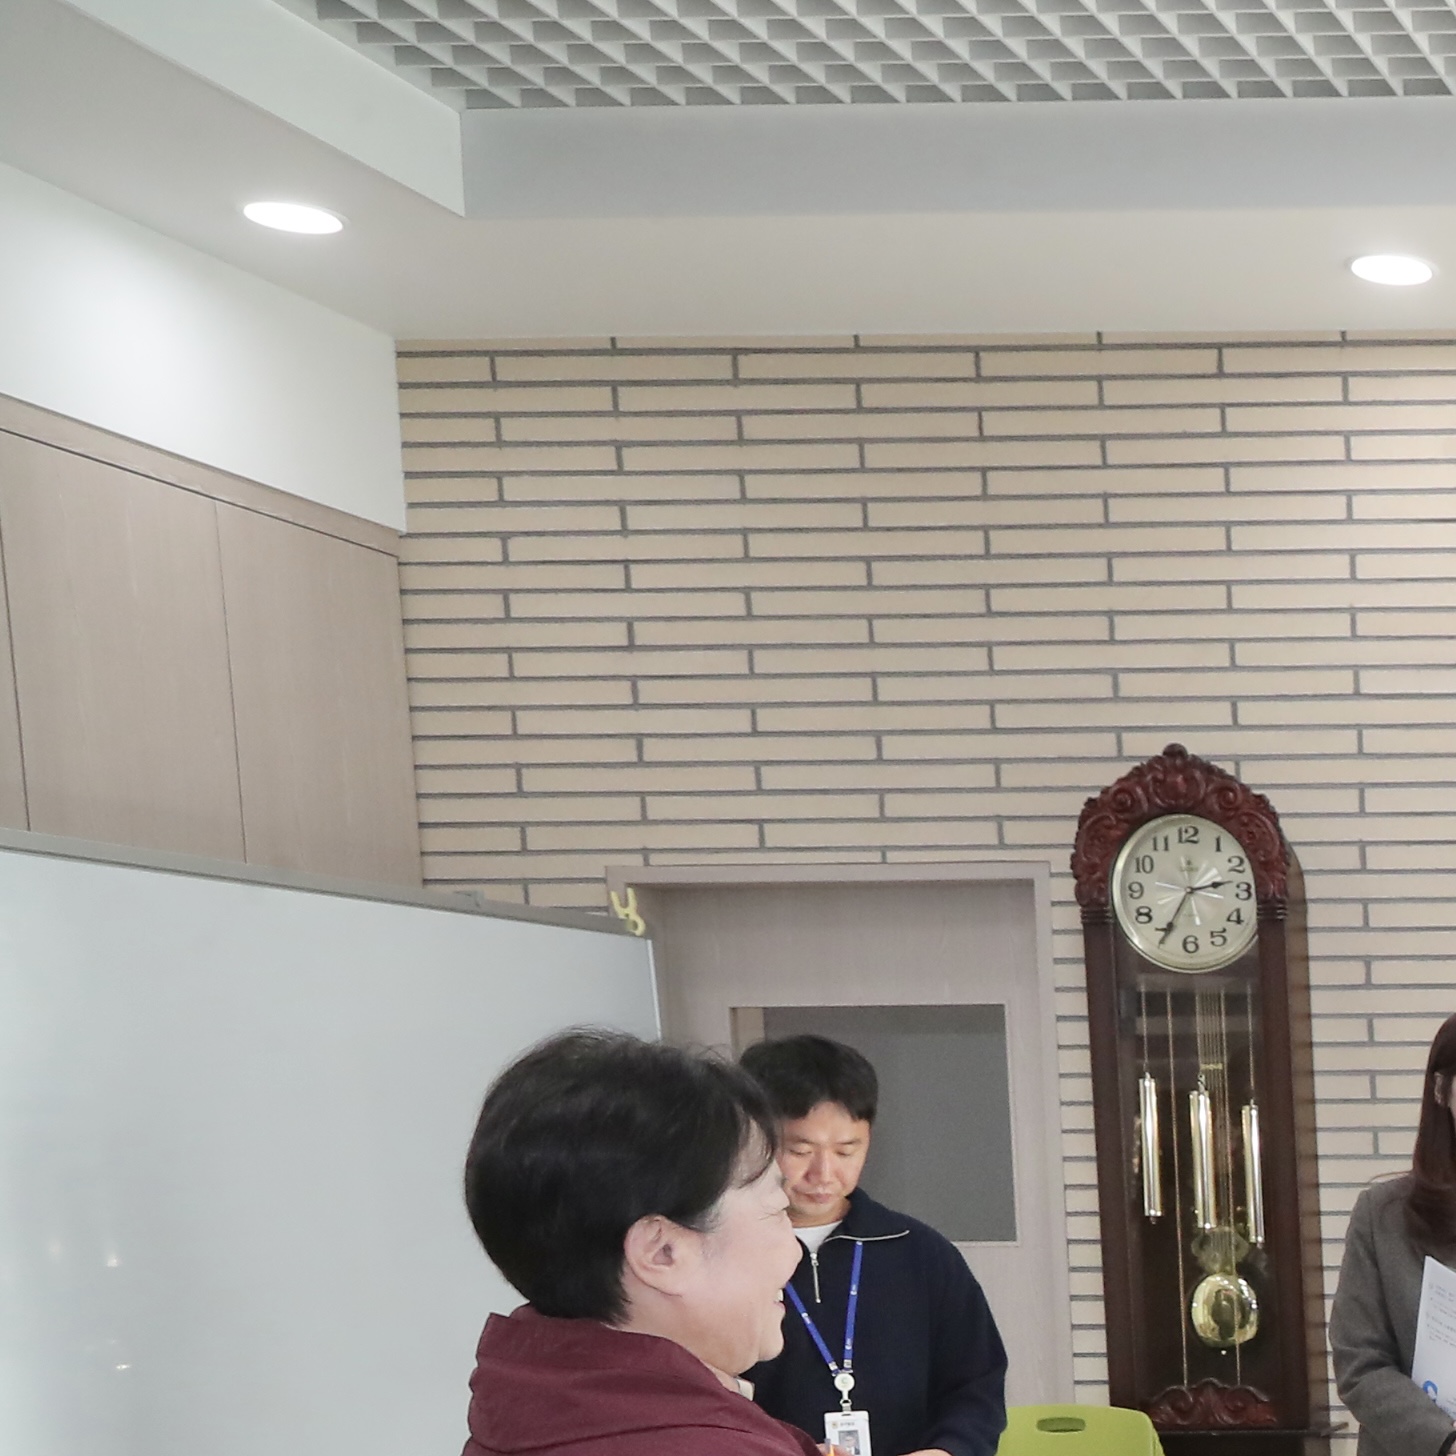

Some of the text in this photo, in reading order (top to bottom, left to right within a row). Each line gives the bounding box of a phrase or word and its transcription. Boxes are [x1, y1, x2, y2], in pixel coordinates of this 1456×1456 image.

[1152, 835, 1169, 851] 11
[1177, 826, 1199, 845] 12
[1214, 836, 1222, 852] 1
[1135, 855, 1154, 874] 10
[1227, 856, 1246, 873] 2
[1128, 882, 1144, 899] 9
[1235, 882, 1252, 900] 3
[1135, 906, 1153, 924] 8
[1226, 908, 1244, 925] 4
[1182, 935, 1199, 954] 6
[1210, 928, 1228, 947] 5
